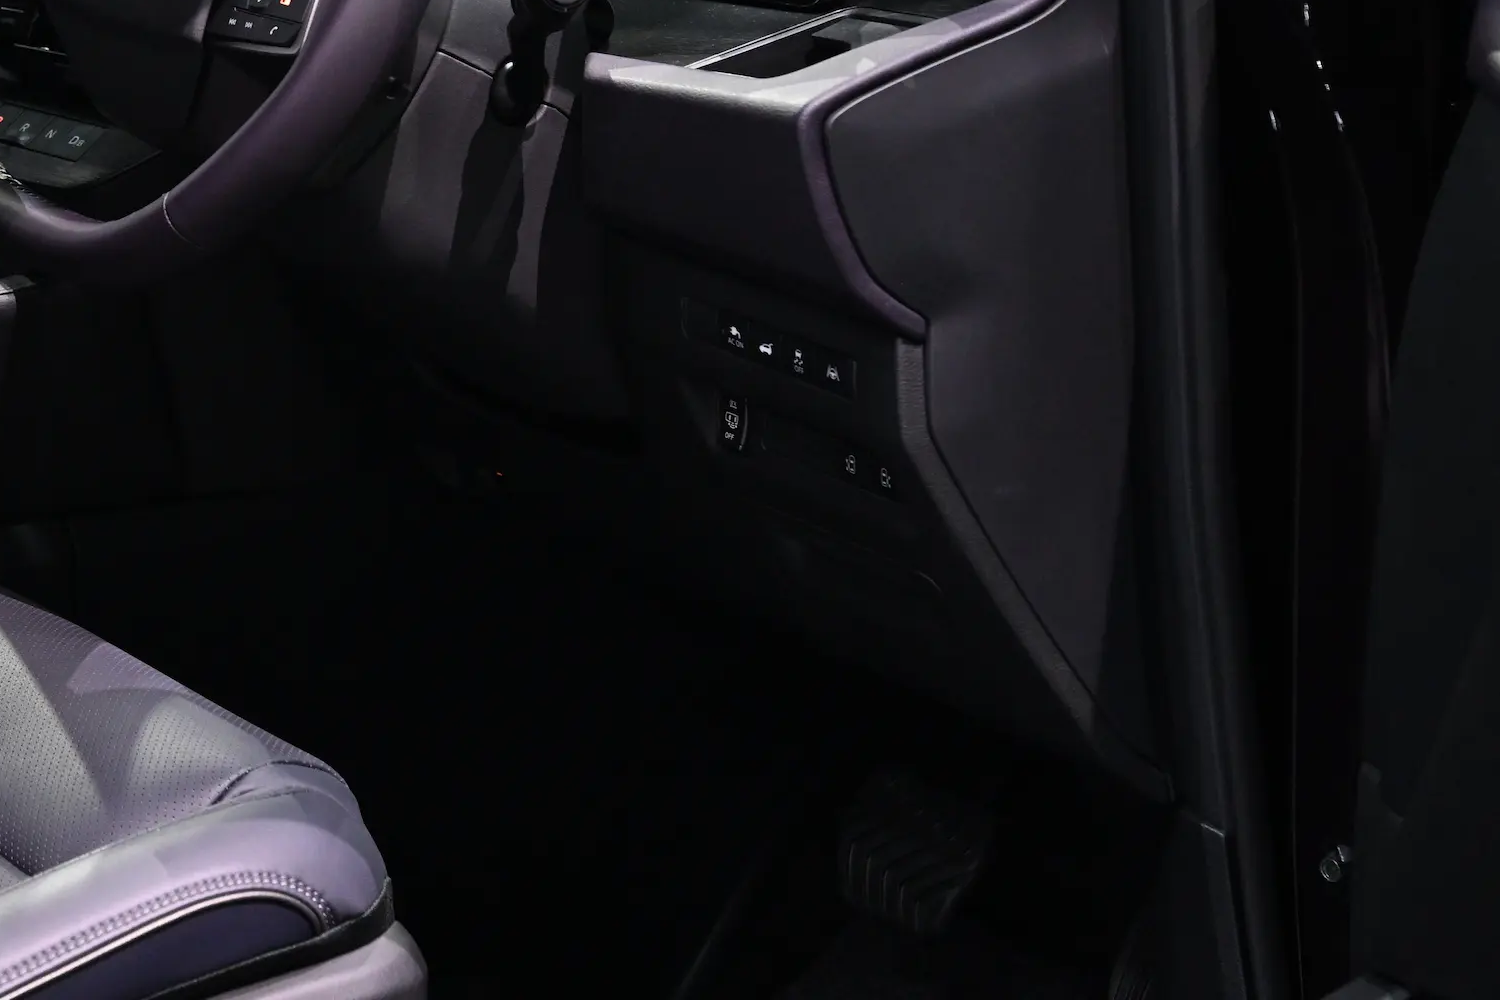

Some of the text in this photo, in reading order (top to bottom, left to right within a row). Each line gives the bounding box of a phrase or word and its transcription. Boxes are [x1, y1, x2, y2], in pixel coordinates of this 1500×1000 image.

[19, 122, 31, 132] R
[44, 128, 58, 139] N
[724, 431, 735, 441] OFF
